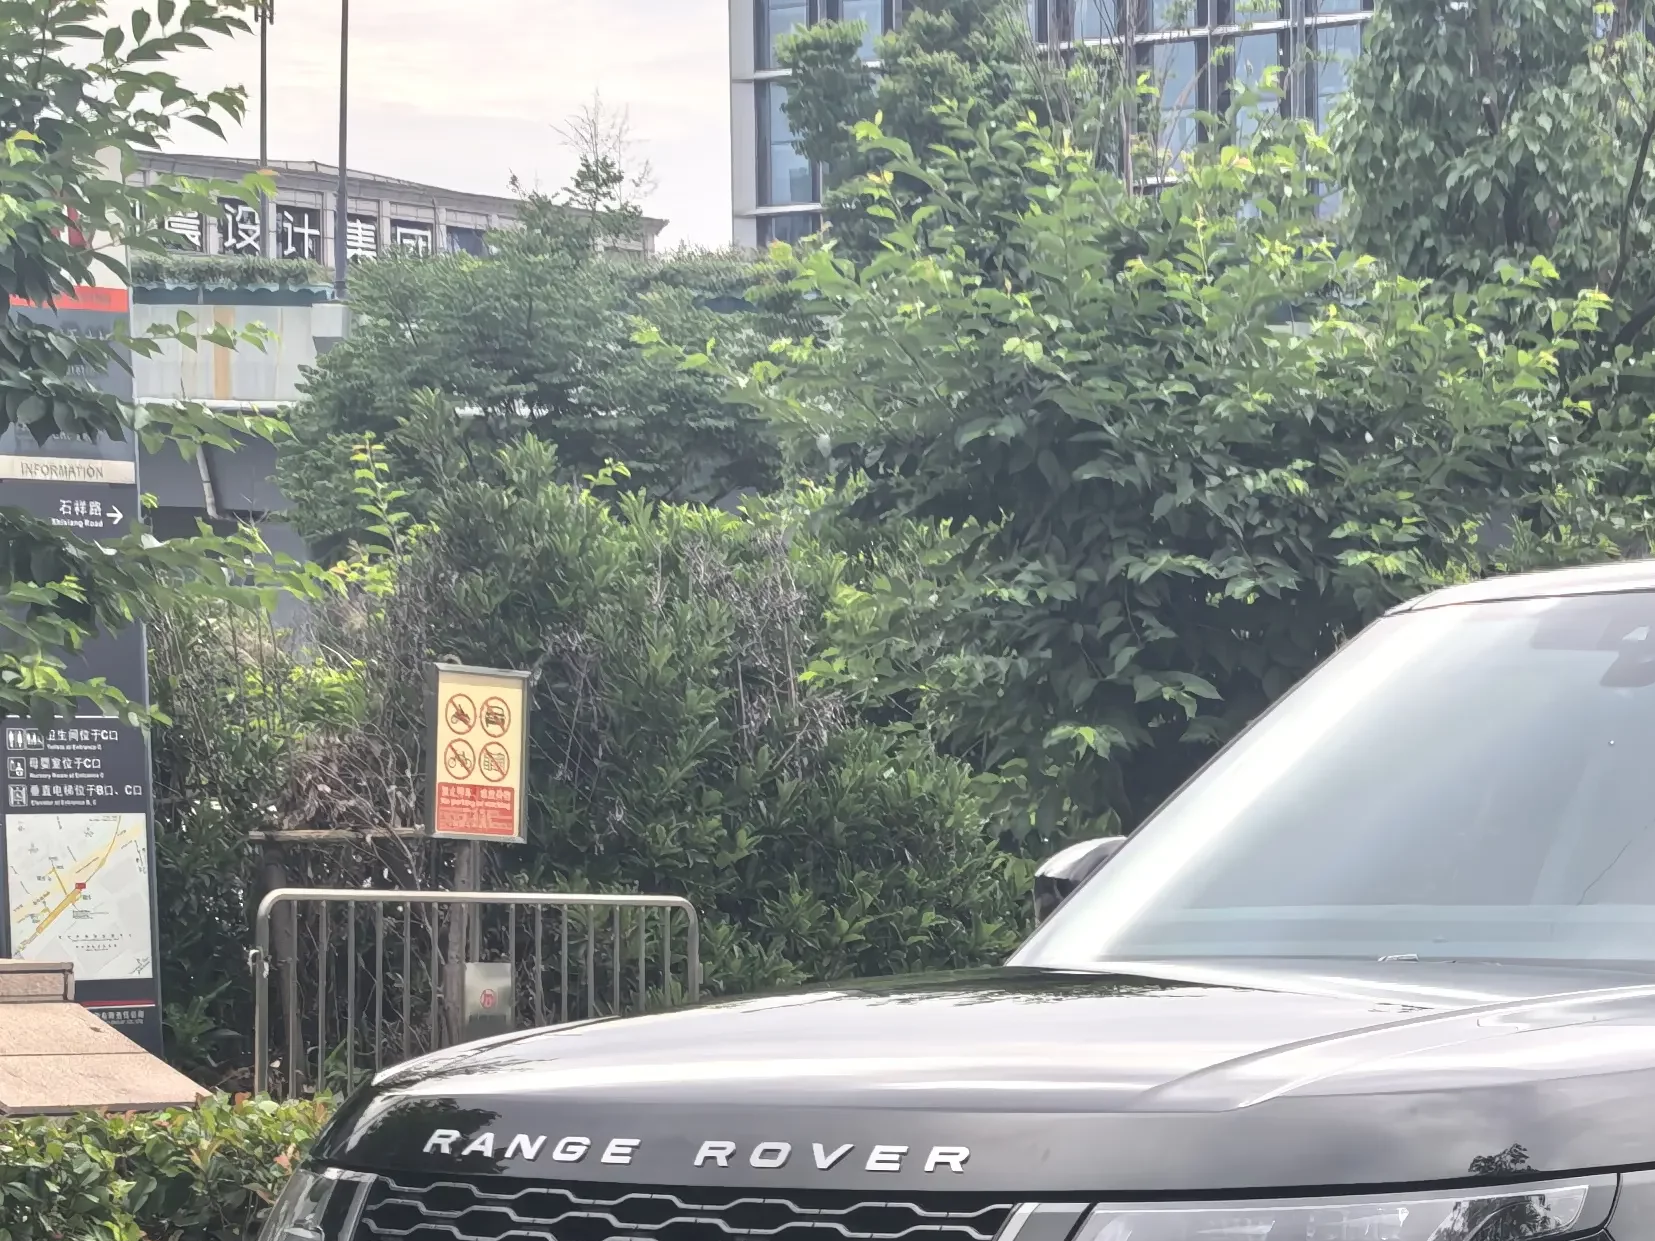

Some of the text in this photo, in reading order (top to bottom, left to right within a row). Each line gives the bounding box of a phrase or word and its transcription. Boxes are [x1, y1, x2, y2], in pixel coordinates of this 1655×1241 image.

[20, 461, 104, 479] INFORMATION
[59, 499, 102, 517] 石祥路
[84, 519, 104, 528] Road
[422, 1128, 971, 1173] RANGE ROVER
